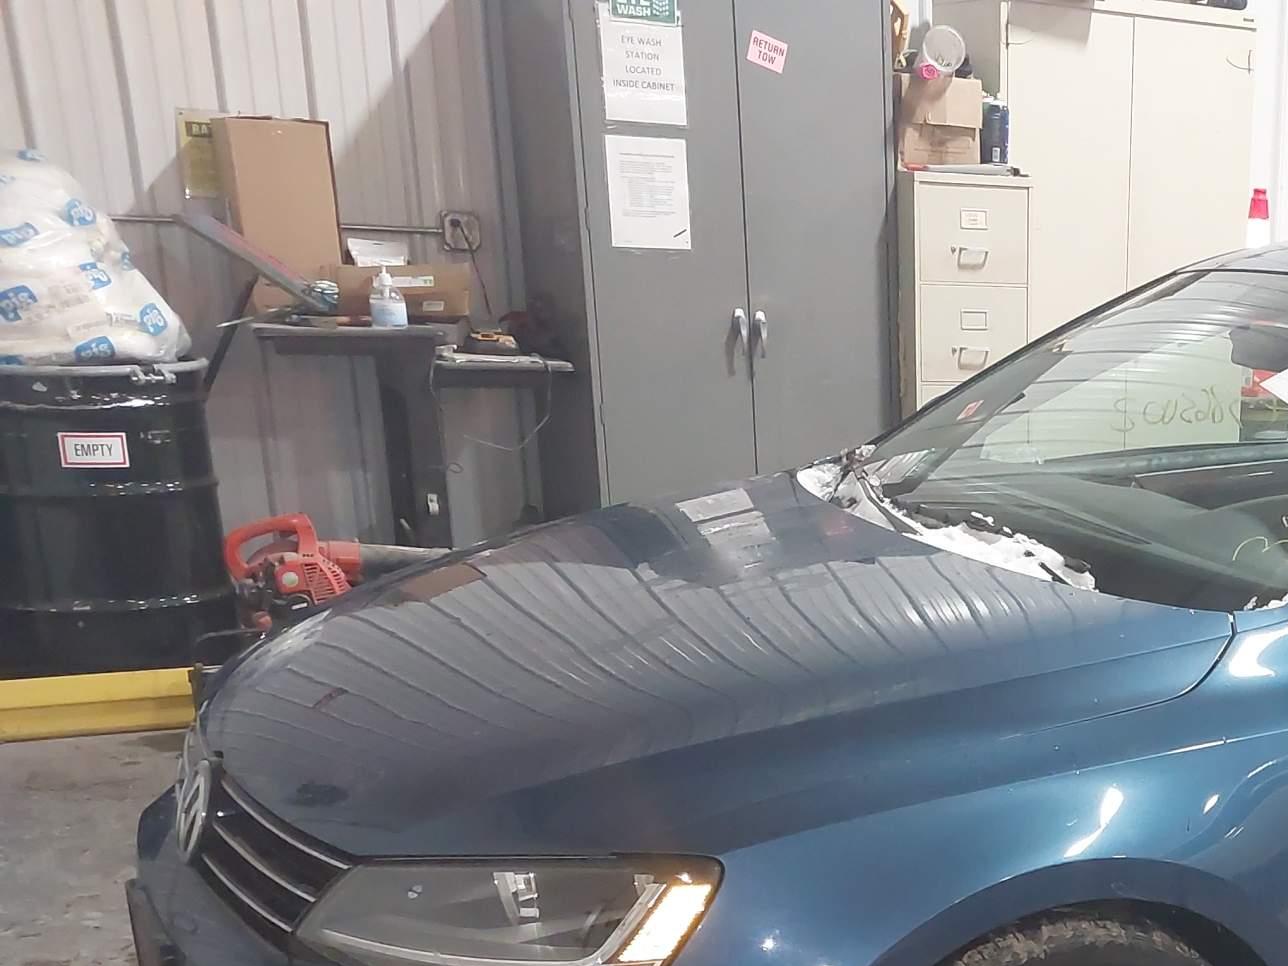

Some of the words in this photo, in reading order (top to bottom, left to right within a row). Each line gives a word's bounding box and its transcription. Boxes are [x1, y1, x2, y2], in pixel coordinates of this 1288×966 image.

[616, 4, 651, 16] WASH
[621, 35, 634, 44] EYE
[638, 38, 662, 47] WASH
[752, 36, 785, 57] RETURN
[625, 50, 660, 61] STATION
[757, 50, 776, 65] TOW
[625, 65, 662, 76] LOCATED
[613, 80, 639, 89] INSIDE
[641, 81, 674, 91] CABINET
[74, 443, 113, 457] EMPTY
